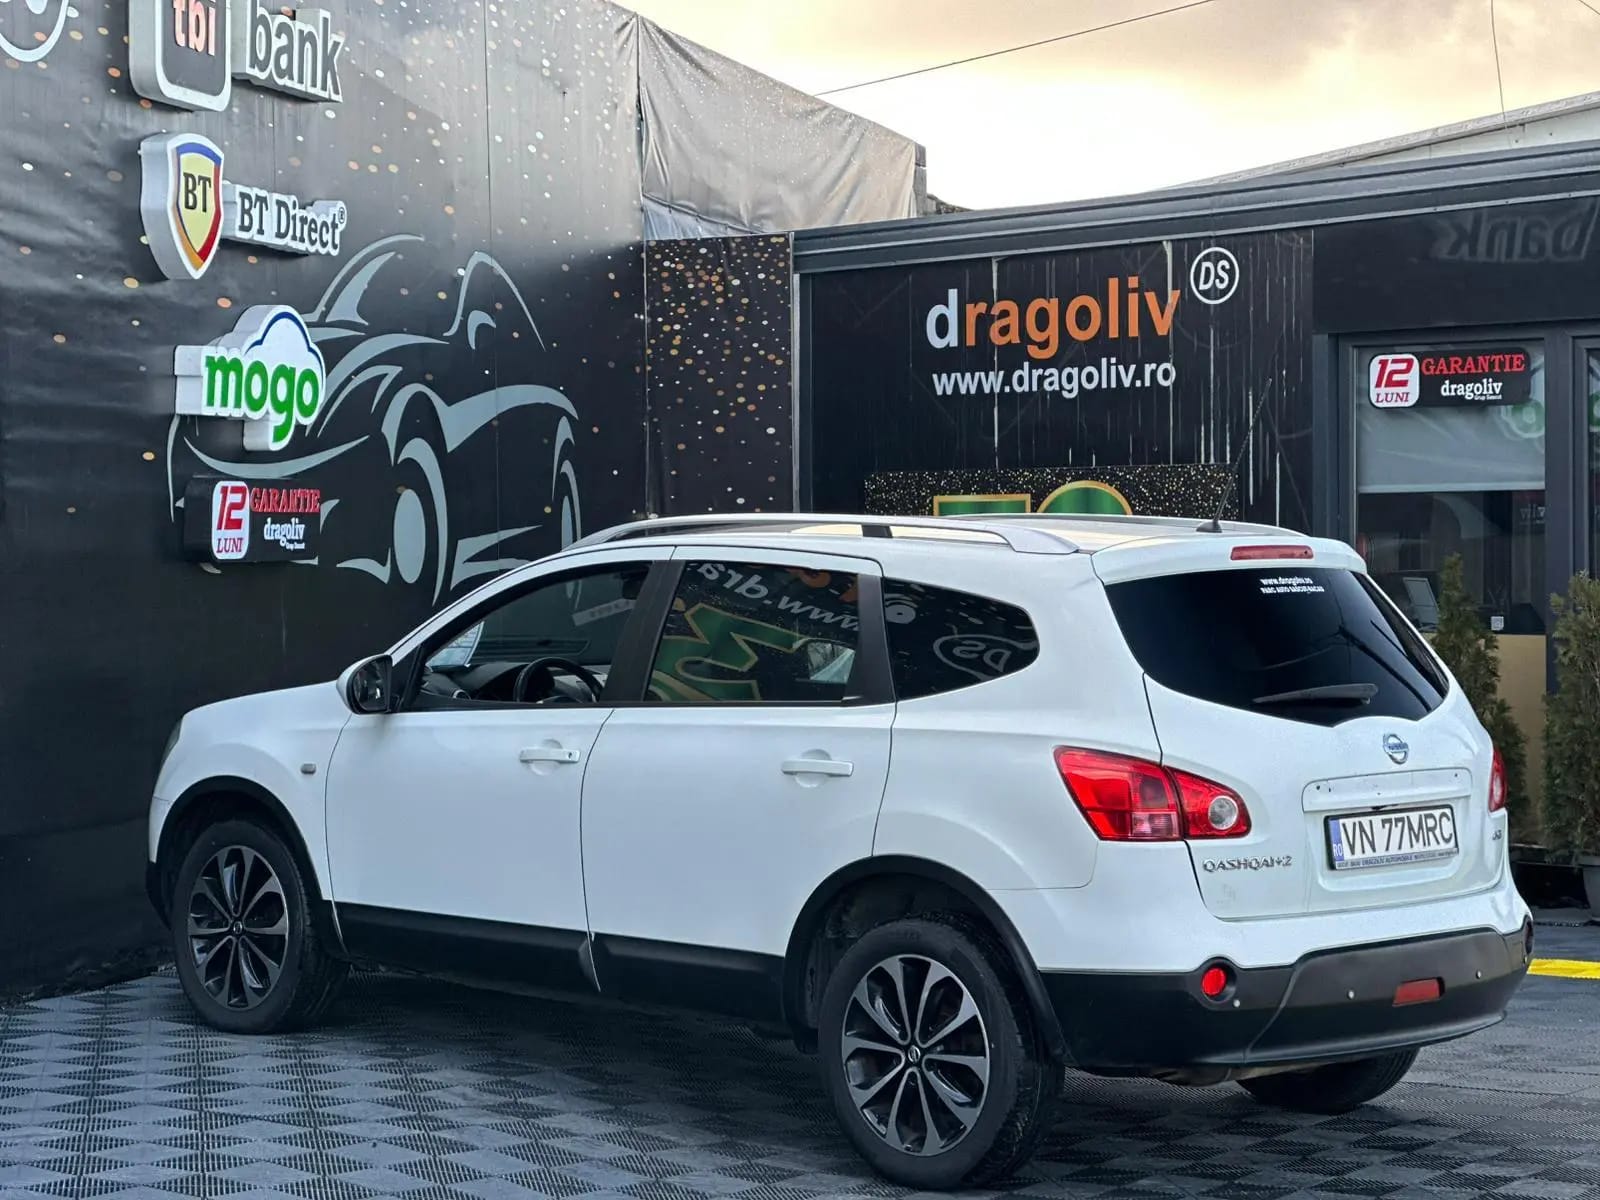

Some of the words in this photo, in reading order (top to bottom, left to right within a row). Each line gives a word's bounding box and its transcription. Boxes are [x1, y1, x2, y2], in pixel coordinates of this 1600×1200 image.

[250, 0, 343, 97] bank
[183, 172, 211, 213] BT
[239, 191, 268, 235] BT
[1199, 261, 1230, 291] DS
[926, 276, 1181, 360] dragoliv
[932, 357, 1176, 399] www.dragoliv.ro
[1375, 358, 1414, 388] 12
[1421, 354, 1525, 375] GARANTIE
[1375, 392, 1409, 403] LUNI
[1440, 378, 1502, 400] dragoliv
[205, 355, 320, 443] mogo
[216, 485, 248, 530] 12
[250, 487, 320, 513] GARANTIE
[216, 538, 243, 553] LUNI
[263, 517, 305, 547] dragoliv
[1333, 843, 1343, 858] RO
[1342, 819, 1375, 856] VN
